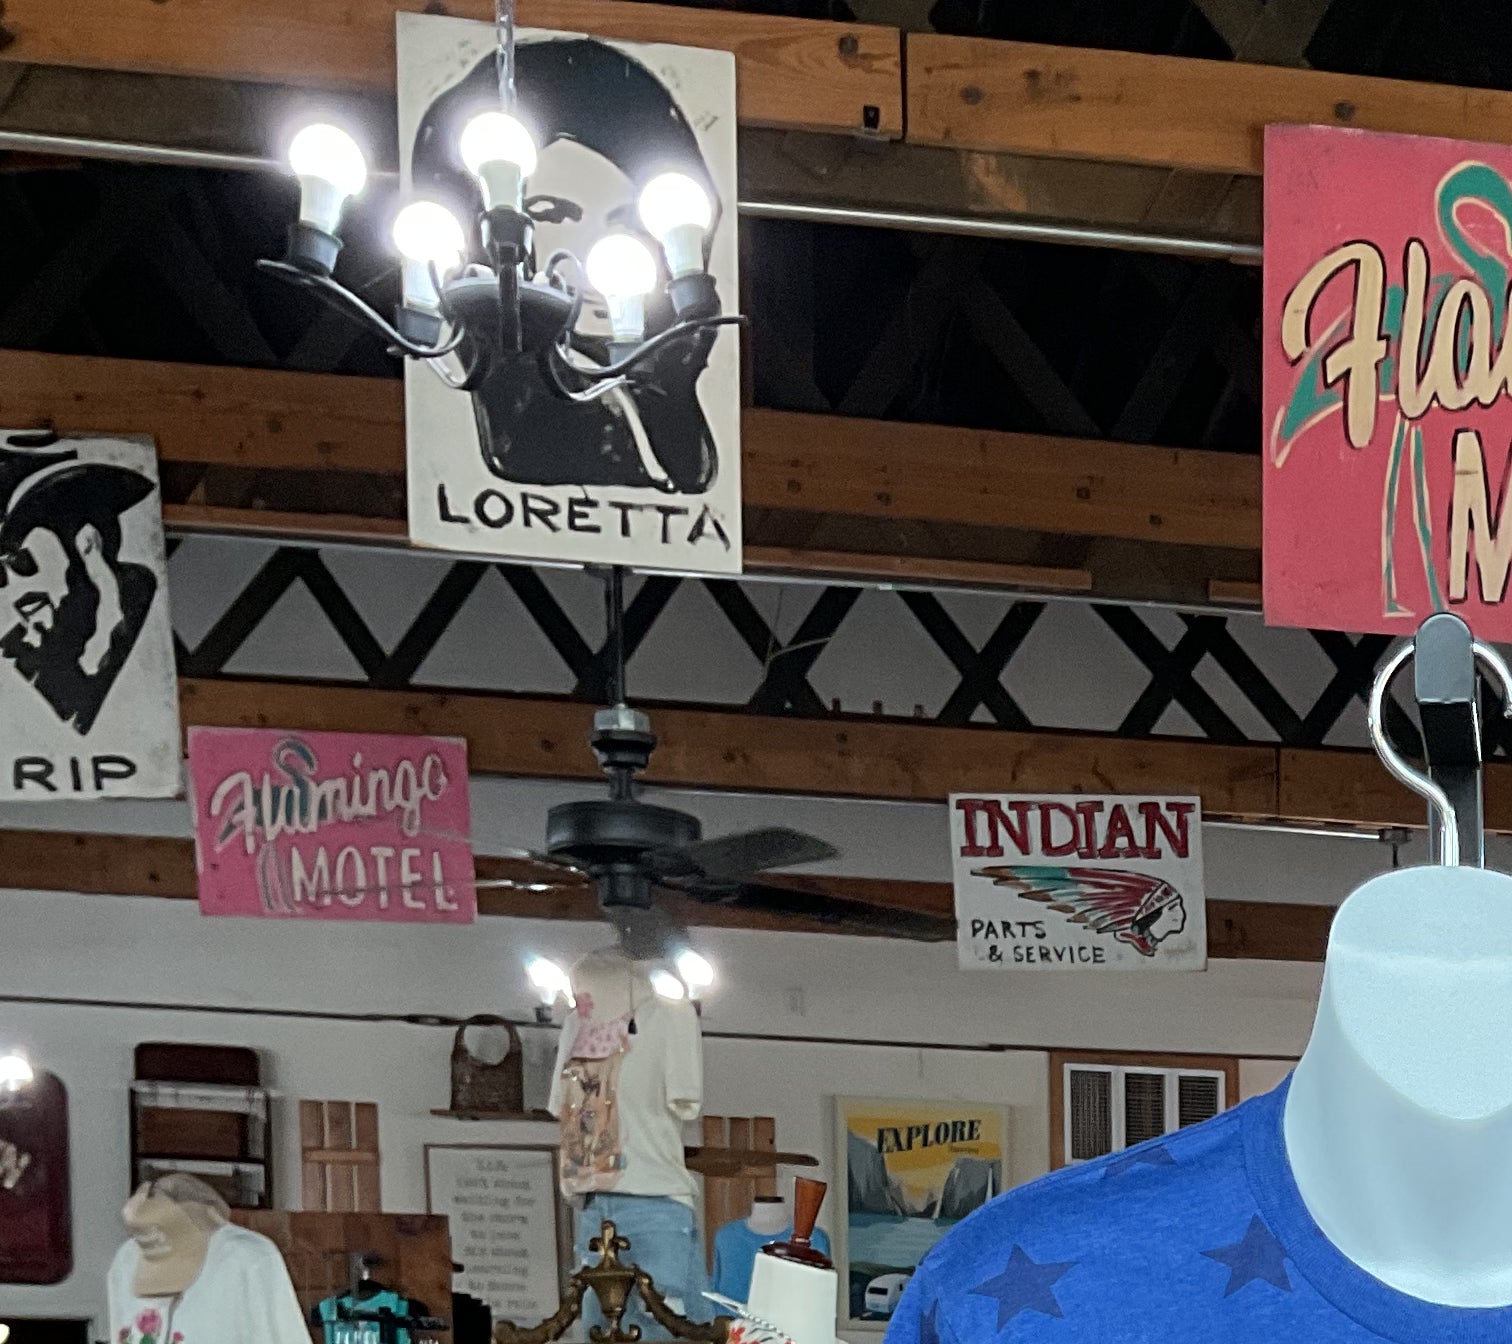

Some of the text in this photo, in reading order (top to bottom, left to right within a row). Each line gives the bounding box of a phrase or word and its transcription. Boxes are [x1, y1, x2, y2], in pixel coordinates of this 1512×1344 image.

[437, 482, 731, 552] LORETTA
[12, 755, 137, 793] RIP
[210, 751, 448, 855] Flamingo
[955, 799, 1195, 859] INDIAN
[291, 845, 458, 911] MOTEL
[970, 919, 1047, 940] PARTS
[988, 945, 1106, 964] & SERVICE
[877, 1119, 982, 1154] EXPLORE
